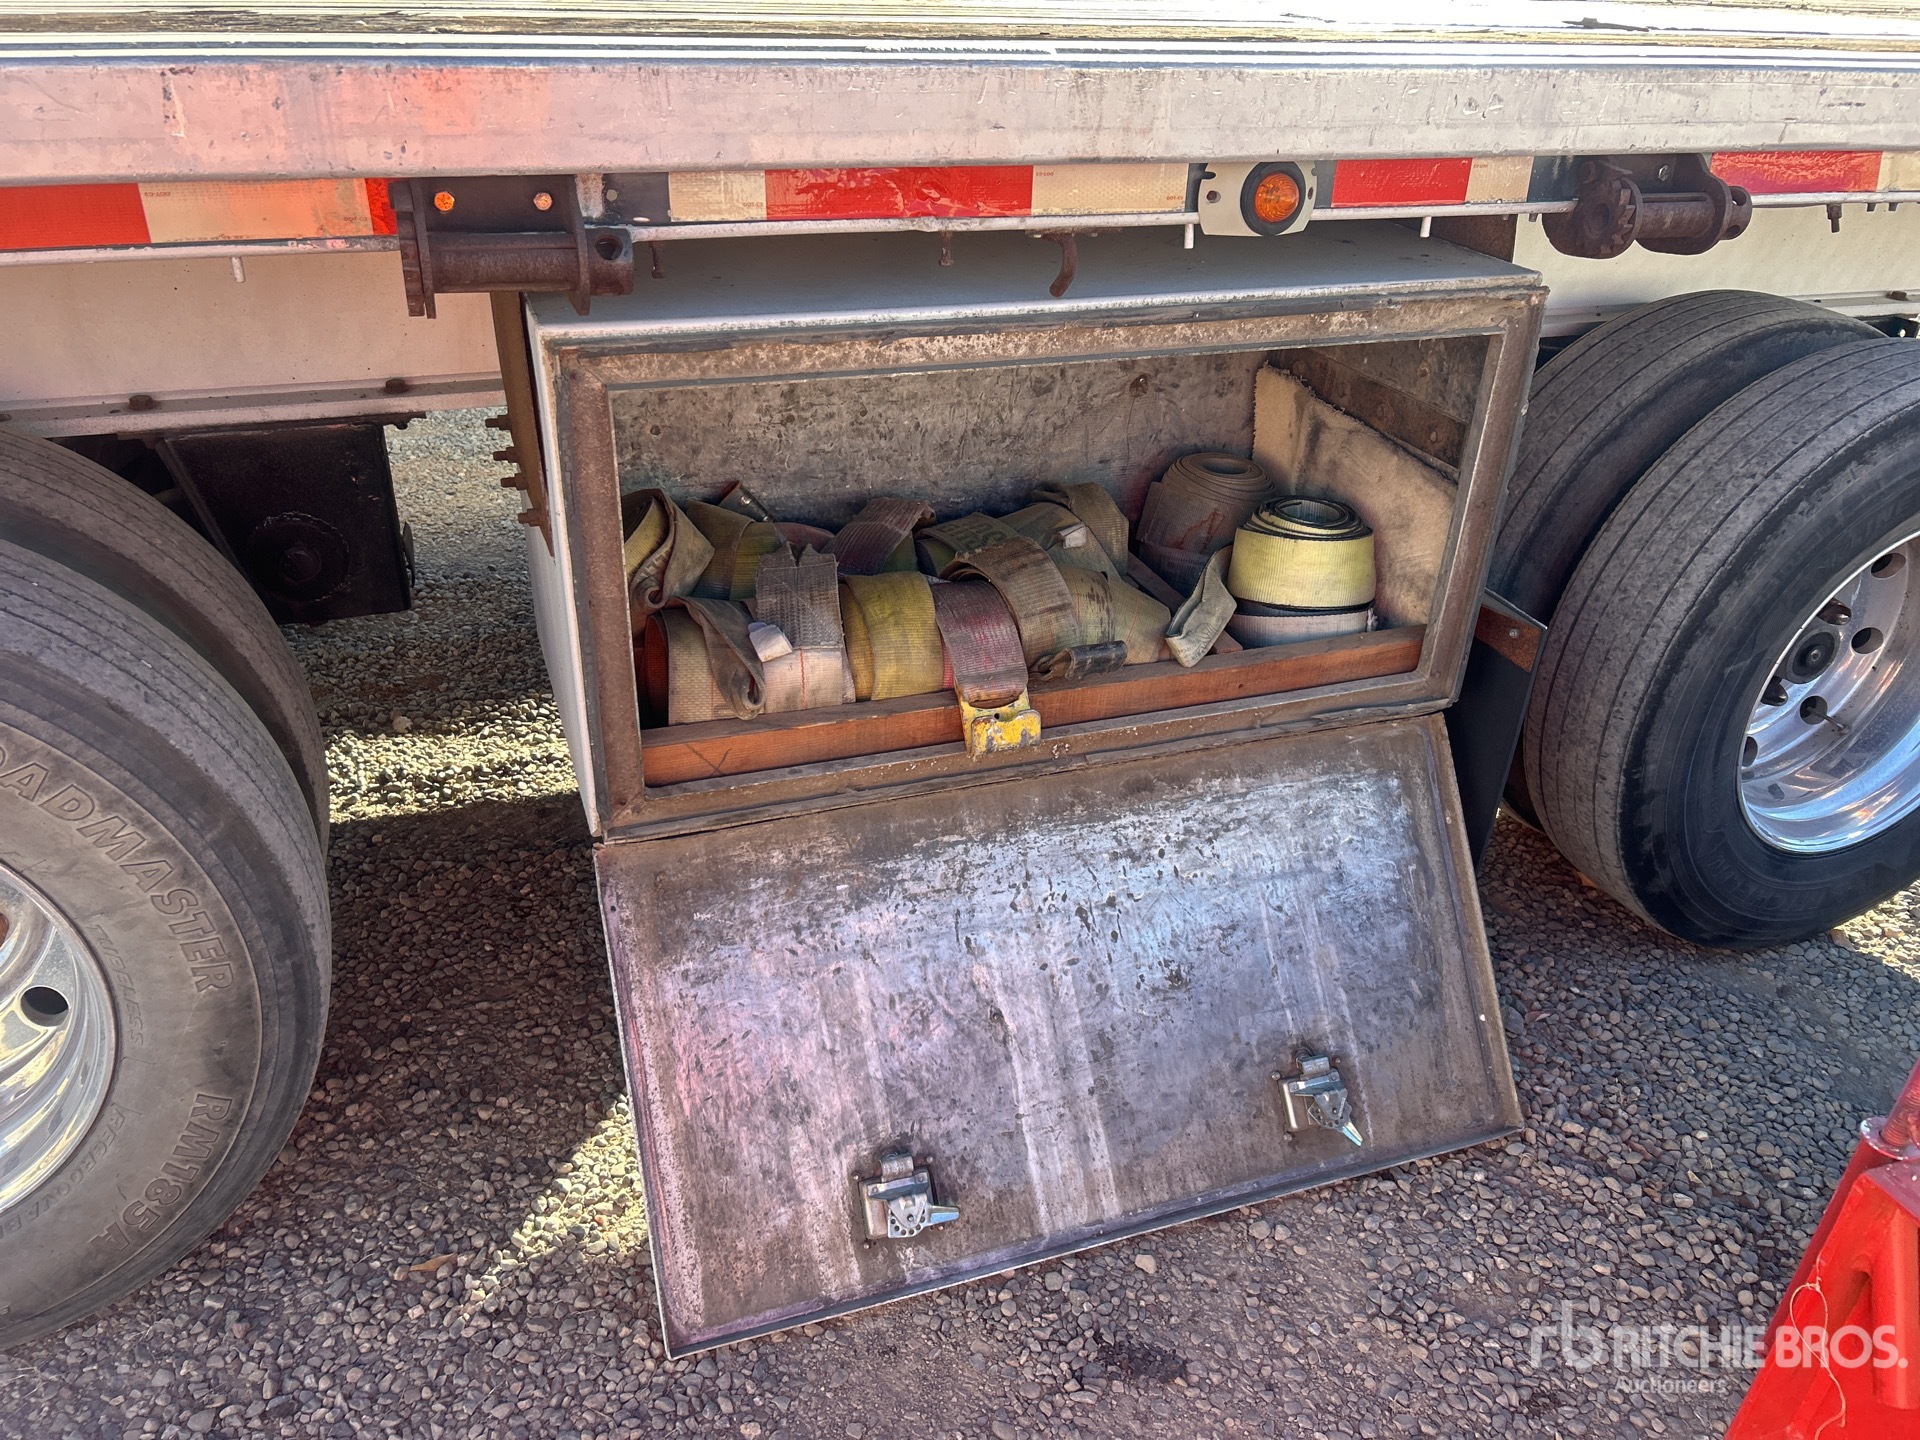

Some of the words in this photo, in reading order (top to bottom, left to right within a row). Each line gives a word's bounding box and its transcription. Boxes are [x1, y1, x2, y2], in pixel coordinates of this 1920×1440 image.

[0, 745, 235, 996] ADMASTER
[86, 924, 144, 1046] TUBELESS
[0, 1107, 126, 1239] REGROOVAB
[89, 1093, 233, 1253] RM185A
